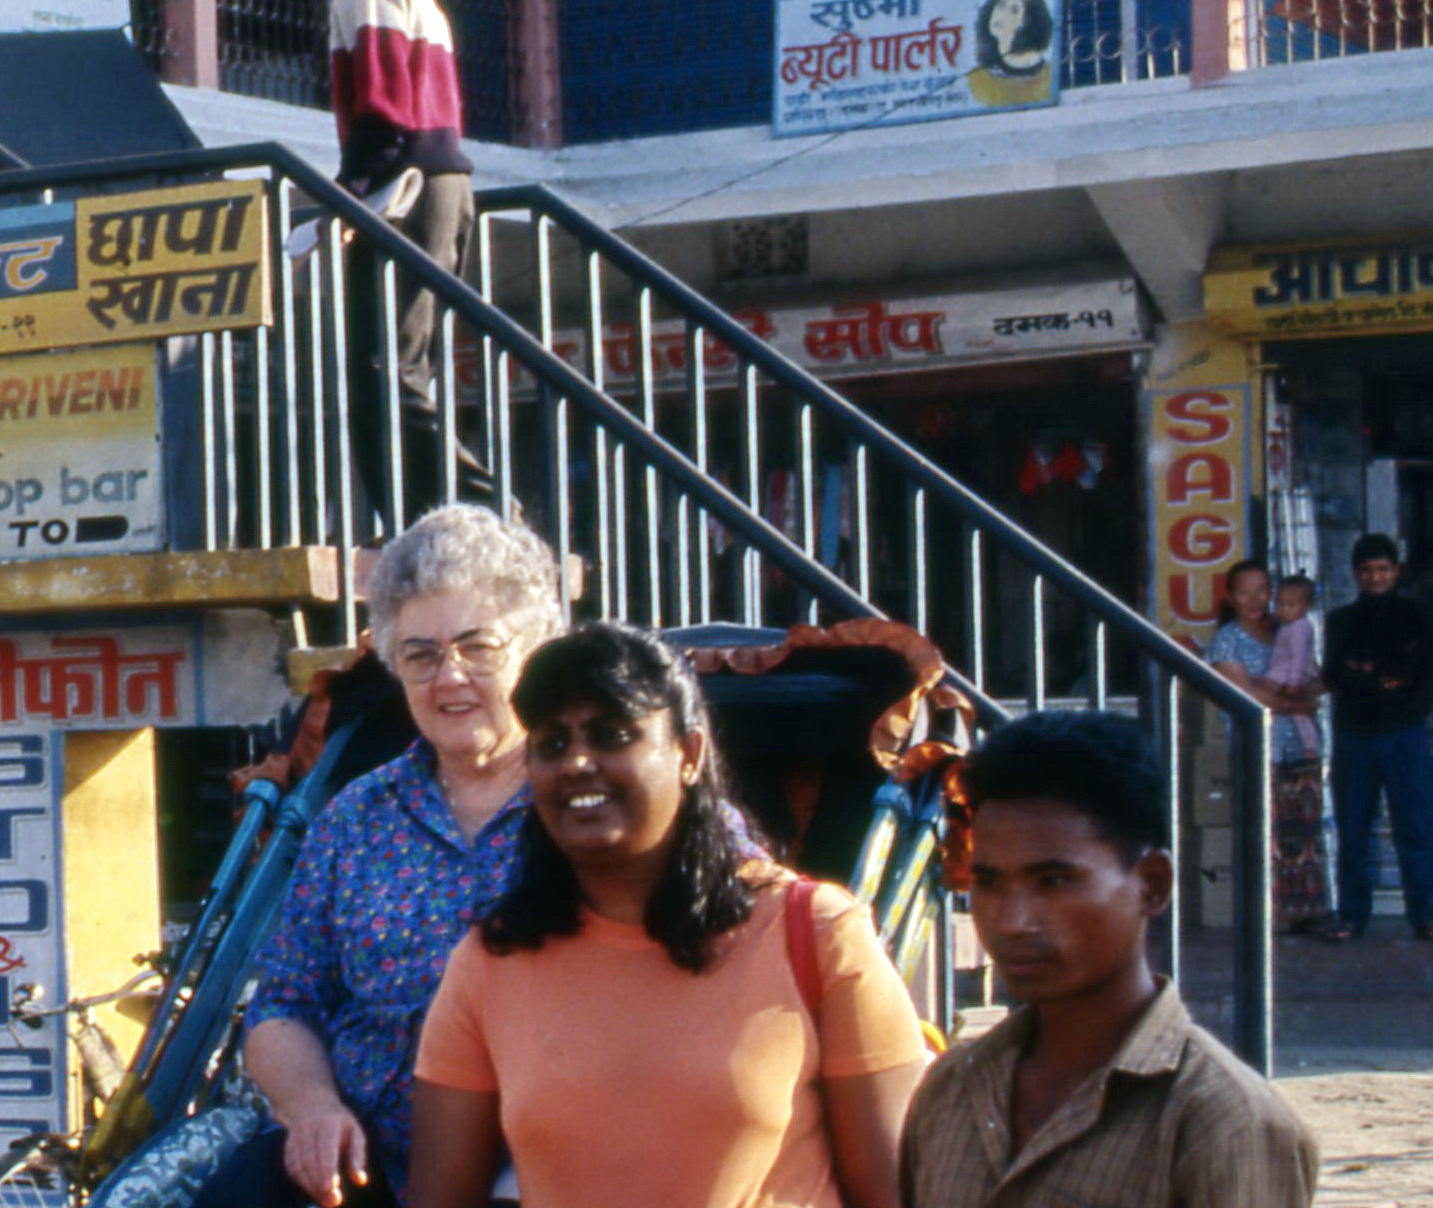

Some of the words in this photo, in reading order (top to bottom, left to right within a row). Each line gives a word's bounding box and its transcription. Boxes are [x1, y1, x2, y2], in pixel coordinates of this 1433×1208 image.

[869, 17, 963, 73] पार्लर
[87, 194, 254, 267] छापा
[86, 260, 259, 331] खाना
[58, 466, 149, 506] bar
[8, 518, 70, 548] TO
[1165, 391, 1234, 650] SAGU
